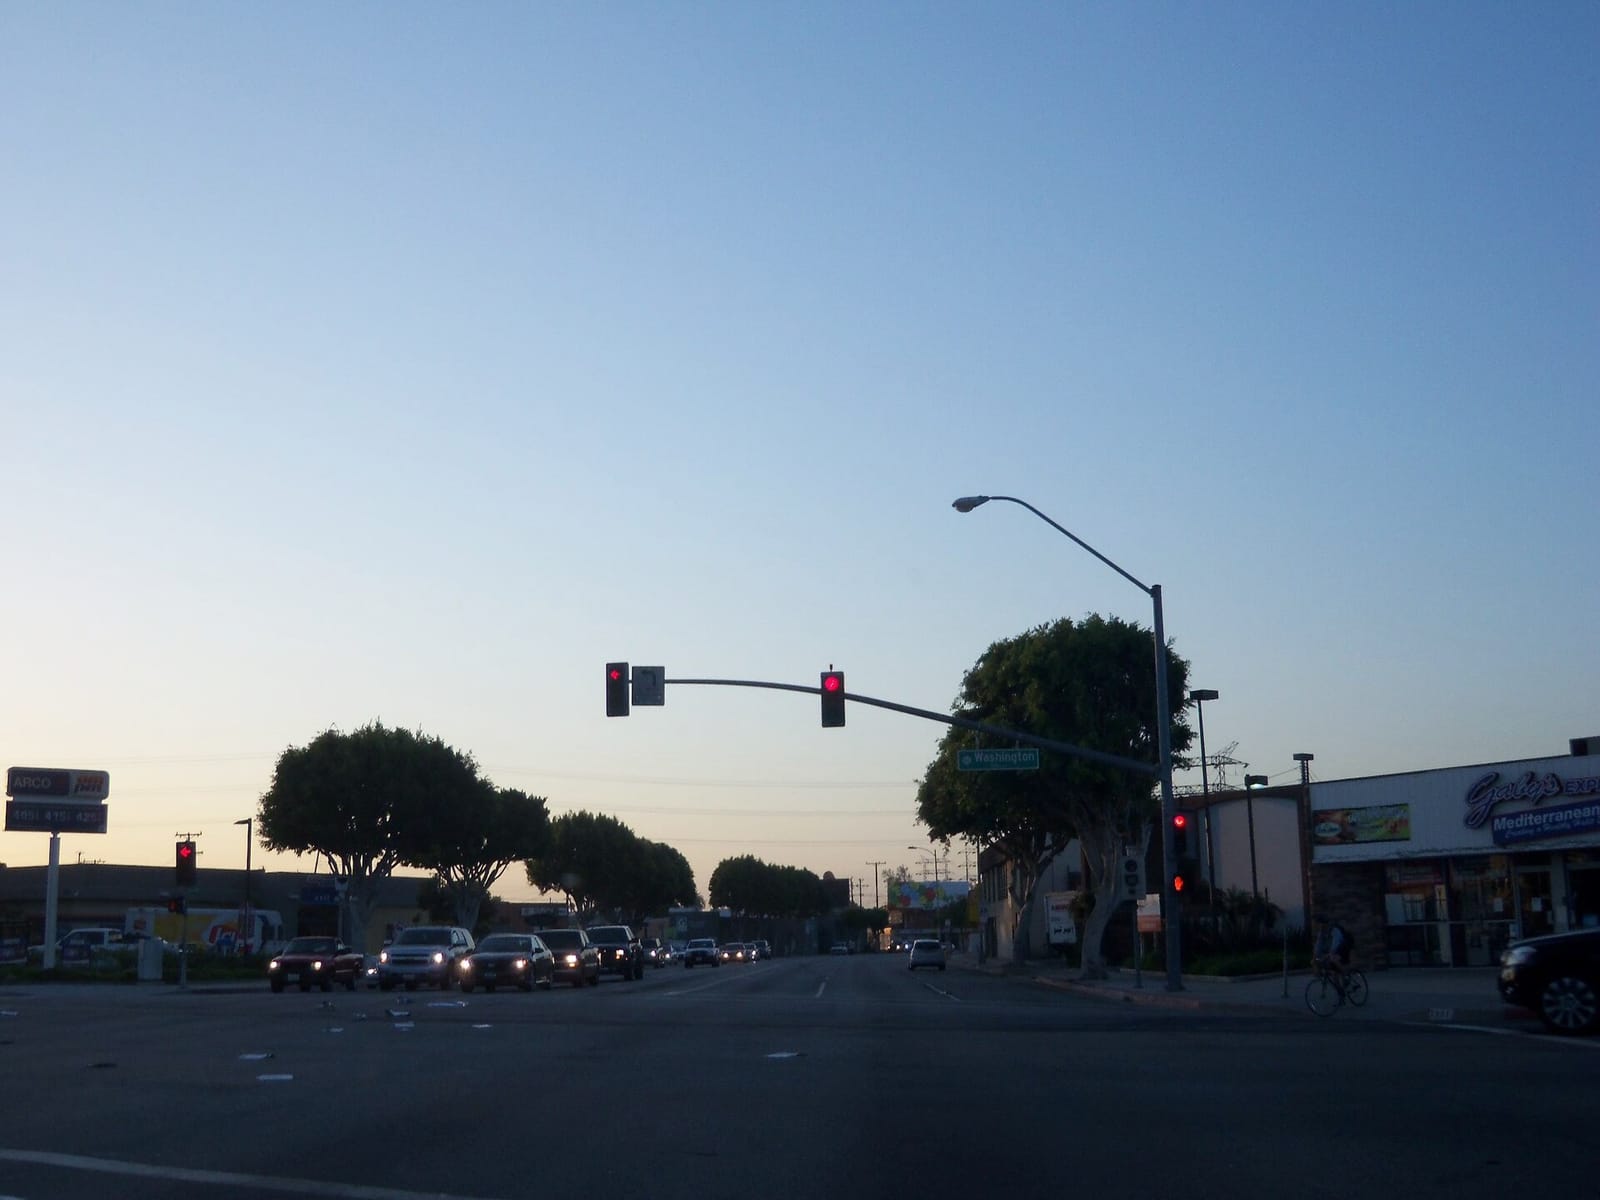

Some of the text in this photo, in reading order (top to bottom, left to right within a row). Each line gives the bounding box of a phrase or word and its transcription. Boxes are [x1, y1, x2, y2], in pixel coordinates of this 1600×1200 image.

[975, 751, 1035, 764] Washington
[14, 776, 52, 789] ARCO
[1565, 777, 1600, 794] EXP
[1494, 804, 1600, 832] Mediterranean
